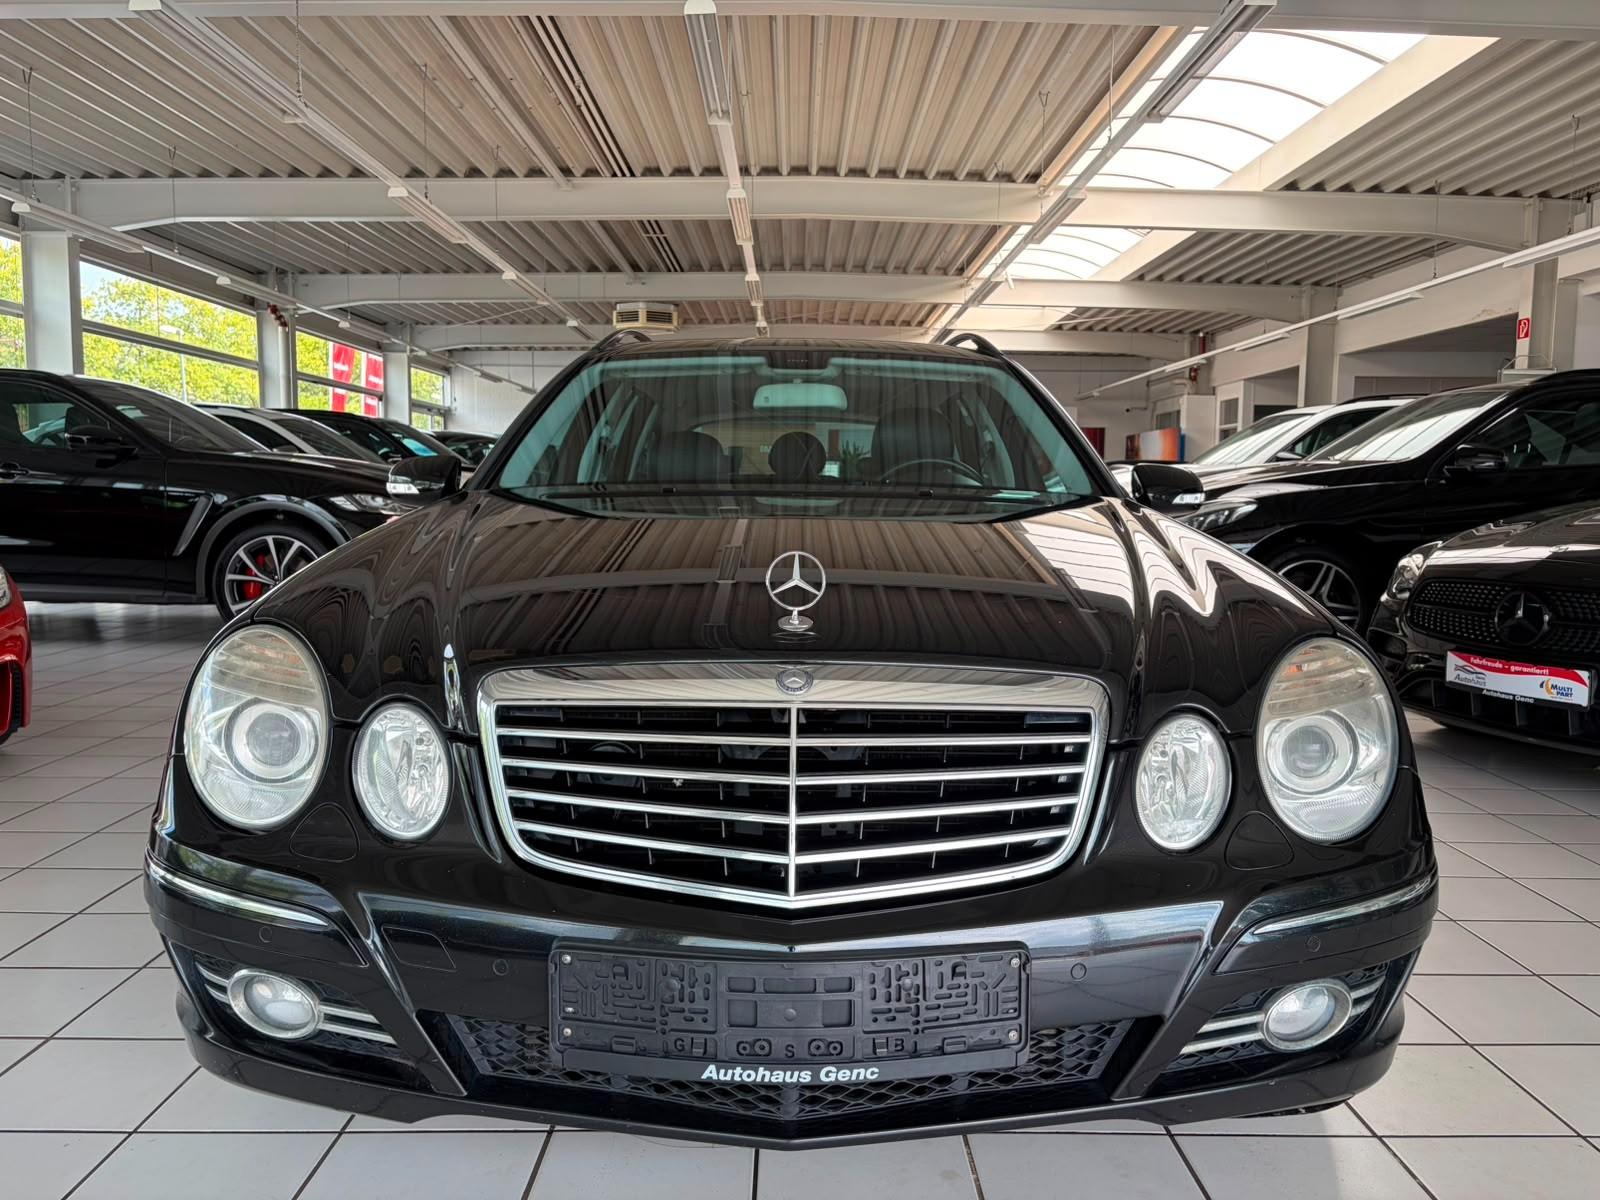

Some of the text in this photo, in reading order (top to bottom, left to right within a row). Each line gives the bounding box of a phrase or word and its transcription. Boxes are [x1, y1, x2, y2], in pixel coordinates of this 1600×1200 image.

[1470, 657, 1503, 669] Fahrfreude
[1454, 673, 1487, 687] Autohaus
[1550, 683, 1573, 692] MULTI
[1482, 689, 1514, 701] Autohaus
[1556, 690, 1573, 698] PART
[701, 1064, 880, 1083] Autohaus Genc
